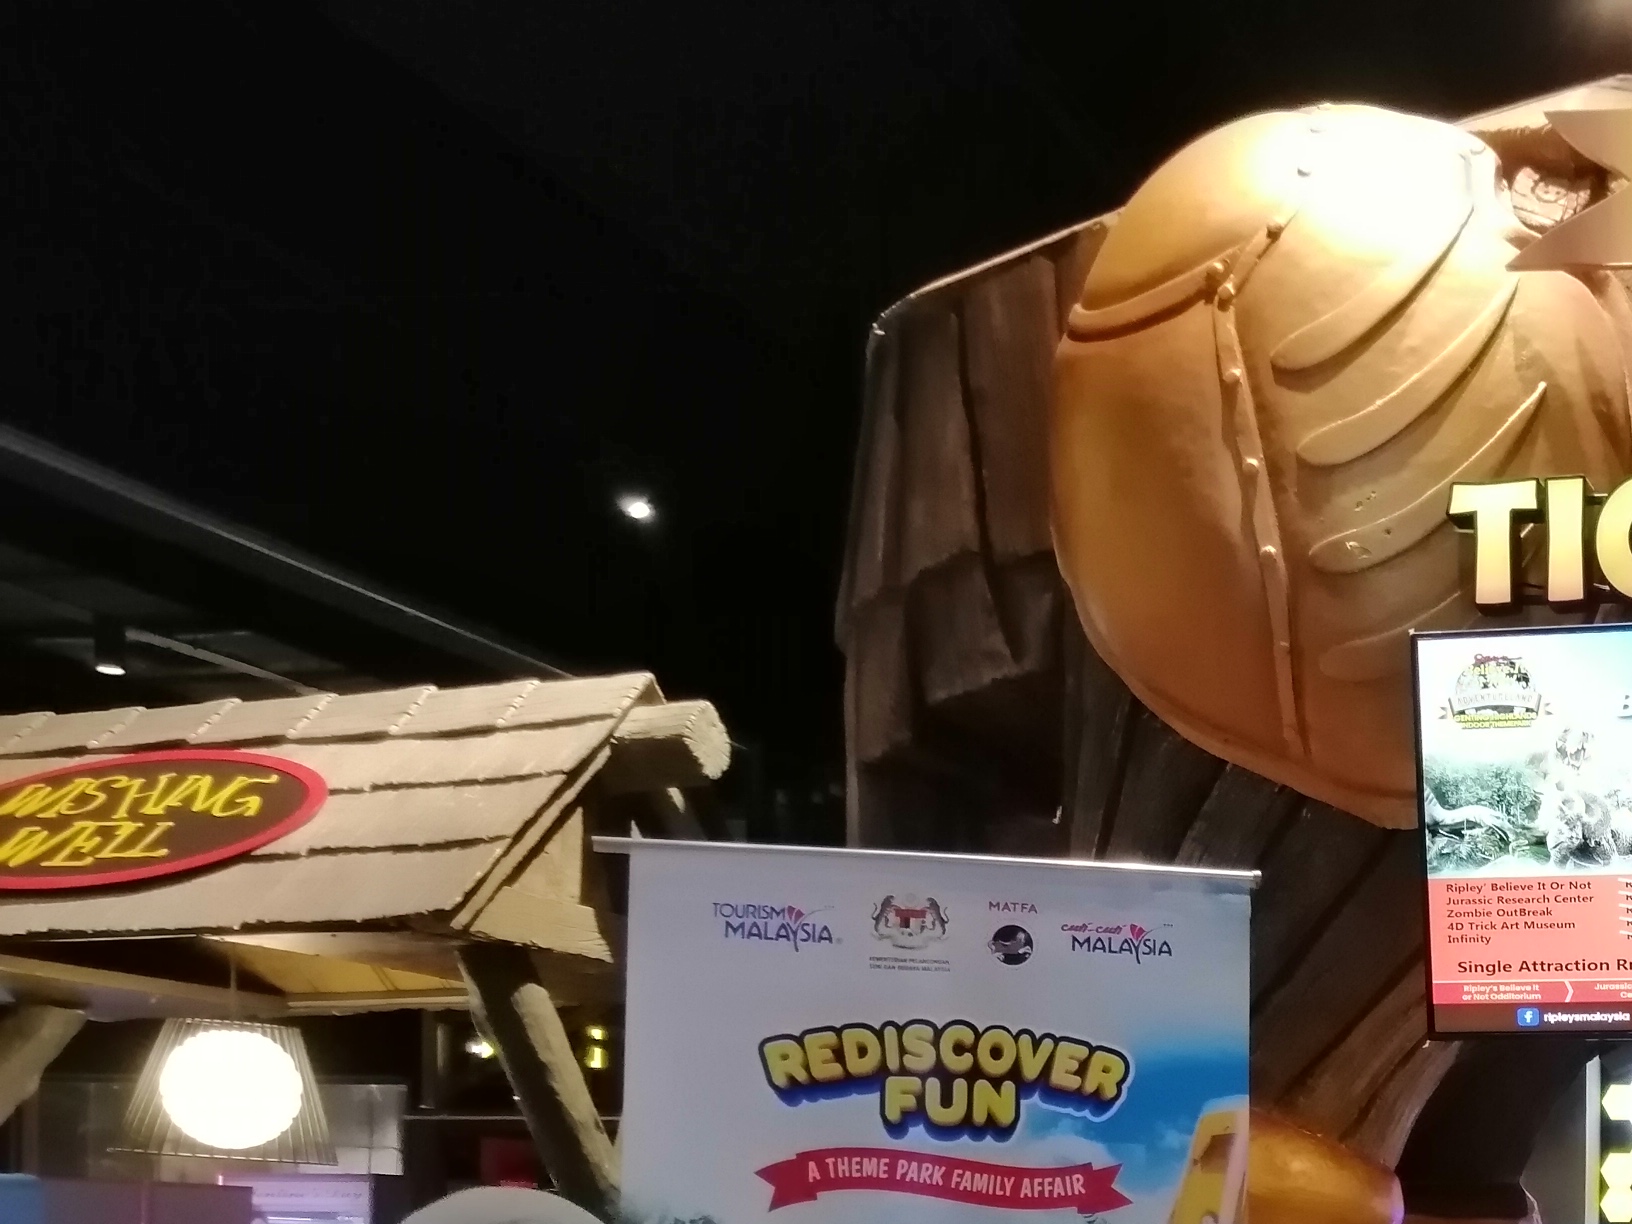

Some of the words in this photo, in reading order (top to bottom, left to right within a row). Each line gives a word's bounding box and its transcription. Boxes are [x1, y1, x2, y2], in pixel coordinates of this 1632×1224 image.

[1491, 882, 1535, 892] Believe
[1537, 881, 1546, 891] It
[1550, 881, 1566, 890] Or
[1569, 880, 1592, 890] Not
[1446, 895, 1493, 906] Jurassic
[1497, 894, 1550, 905] Research
[1554, 893, 1594, 904] Center
[712, 902, 786, 920] TOURISM
[988, 900, 1038, 914] MATFA
[1446, 908, 1493, 918] Zombie
[1496, 906, 1553, 917] OutBreak
[1447, 921, 1464, 931] 4D
[1468, 920, 1497, 931] Trick
[1500, 920, 1520, 930] Art
[1524, 920, 1576, 930] Museum
[724, 920, 833, 952] MALAYSIA
[1447, 934, 1492, 945] Infinity
[1071, 934, 1173, 965] MALAYSIA
[1457, 959, 1513, 976] Single
[1518, 958, 1610, 973] Attraction
[1500, 983, 1532, 992] Believe
[1594, 982, 1632, 991] Jurassic
[1472, 993, 1489, 1001] Not
[761, 1021, 1131, 1106] REDISCOVER
[882, 1074, 1018, 1133] FUN
[808, 1160, 820, 1183] A
[826, 1156, 889, 1179] THEME
[896, 1159, 944, 1186] PARK
[951, 1169, 1015, 1197] FAMILY
[1020, 1173, 1086, 1199] AFFAIR
